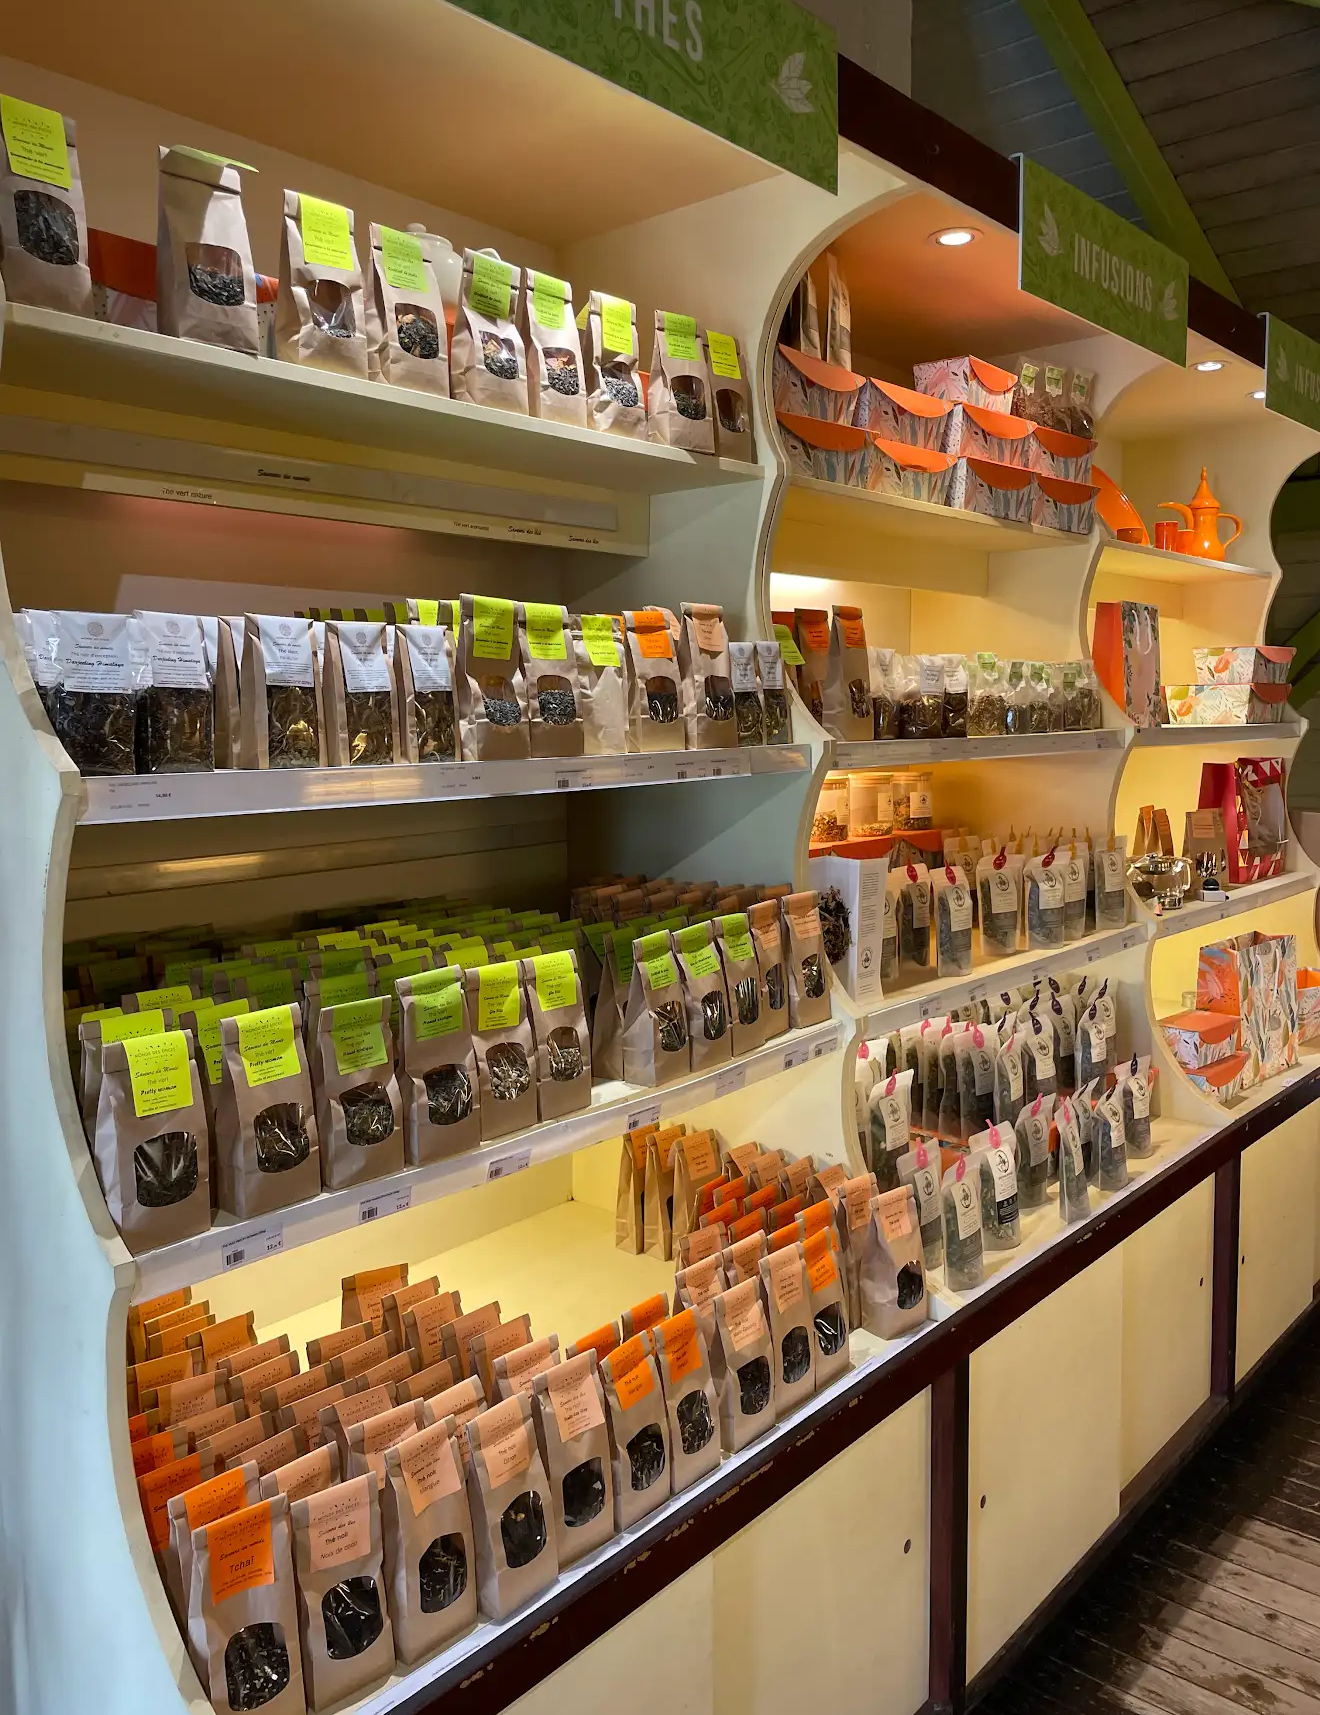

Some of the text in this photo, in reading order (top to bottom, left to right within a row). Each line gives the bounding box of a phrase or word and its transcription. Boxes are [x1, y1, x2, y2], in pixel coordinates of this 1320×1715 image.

[1074, 232, 1152, 312] INFUSIONS
[66, 659, 94, 667] Darjeeling
[250, 1059, 264, 1068] Pretty
[498, 1447, 507, 1456] Thé
[427, 1469, 436, 1478] noir
[420, 1479, 440, 1495] Mangue
[318, 1527, 337, 1538] Saveurs
[325, 1531, 349, 1545] Thé noir
[219, 1548, 239, 1561] Saveurs
[320, 1551, 334, 1559] Noix
[344, 1541, 357, 1551] coco
